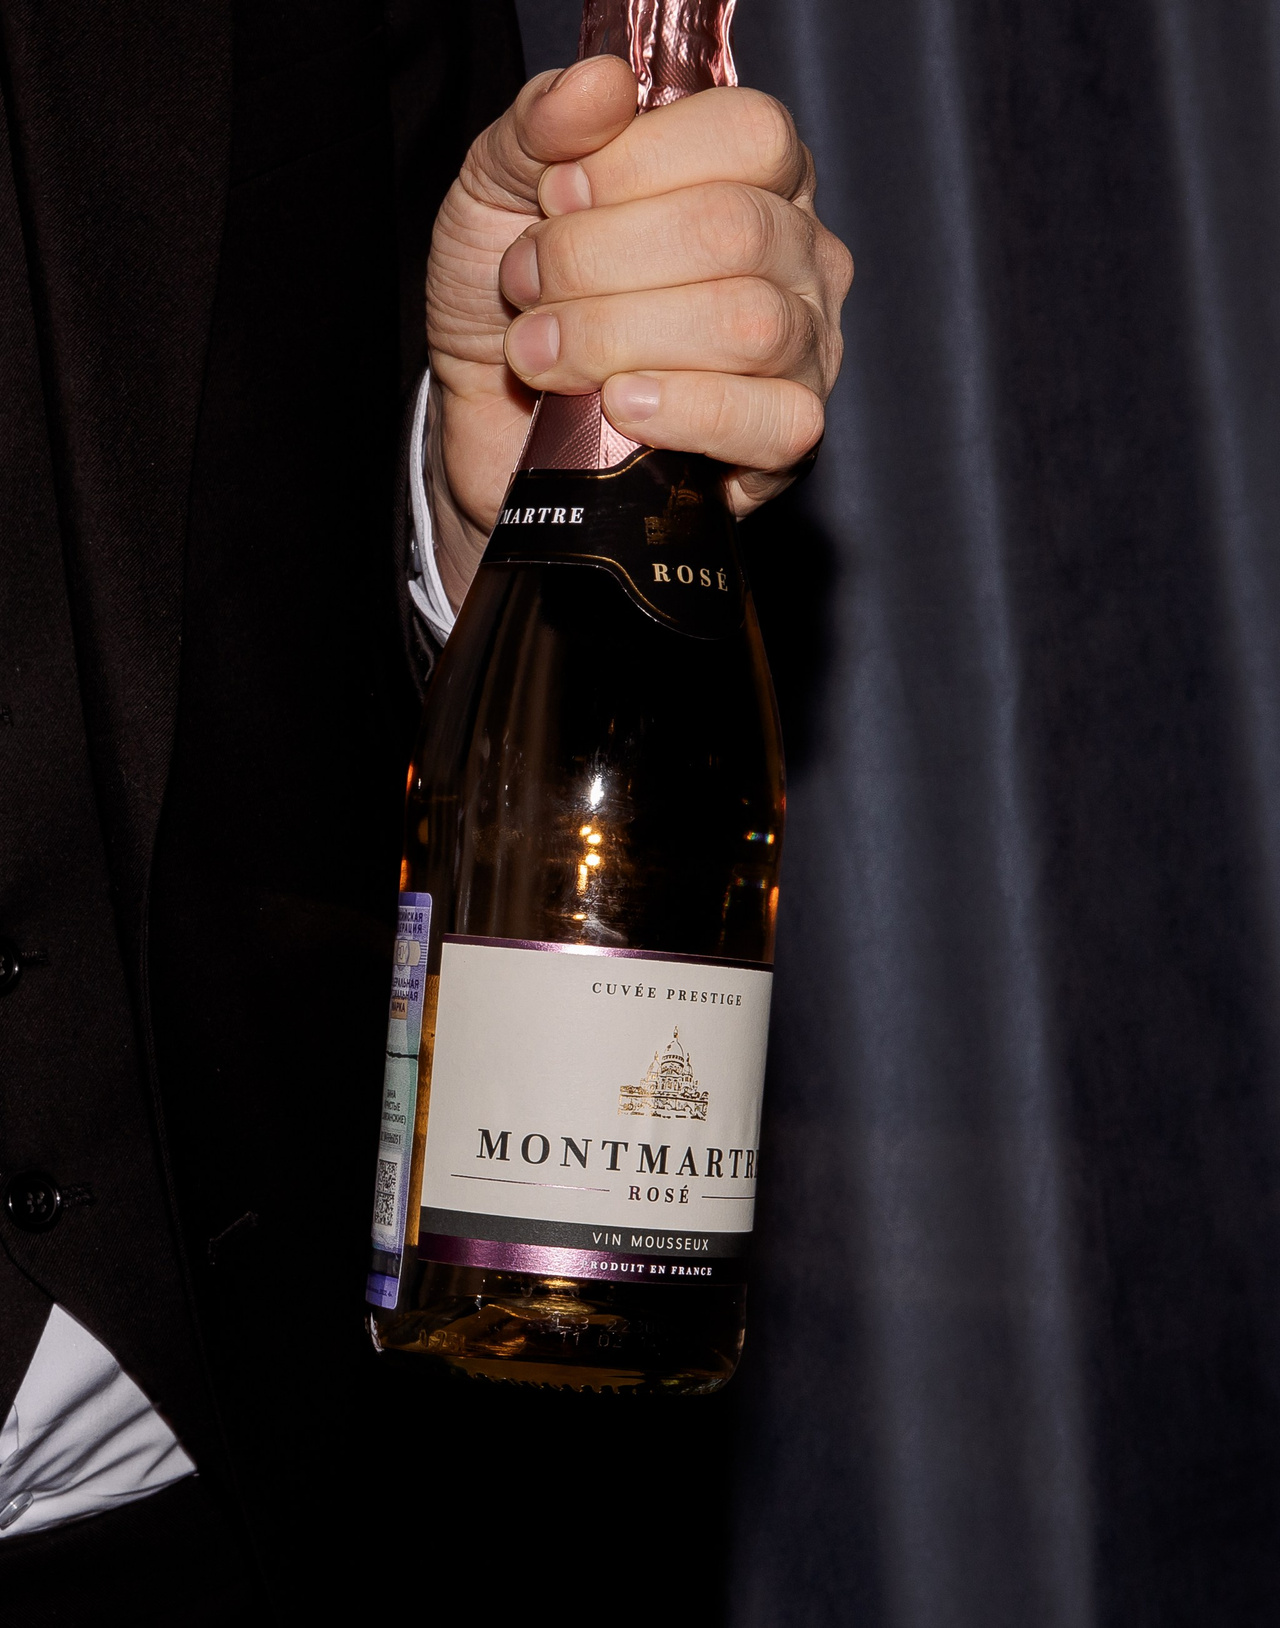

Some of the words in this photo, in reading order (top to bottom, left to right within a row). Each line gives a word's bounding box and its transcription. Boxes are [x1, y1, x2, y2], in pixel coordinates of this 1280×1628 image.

[651, 563, 728, 592] ROSÉ
[592, 982, 657, 999] CUVÉE
[666, 988, 742, 1007] PRESTIGE
[628, 1184, 689, 1204] ROSÉ
[592, 1231, 621, 1247] VIN
[631, 1235, 709, 1251] MOUSSEUX
[650, 1264, 666, 1275] EN
[671, 1265, 712, 1276] FRANCE
